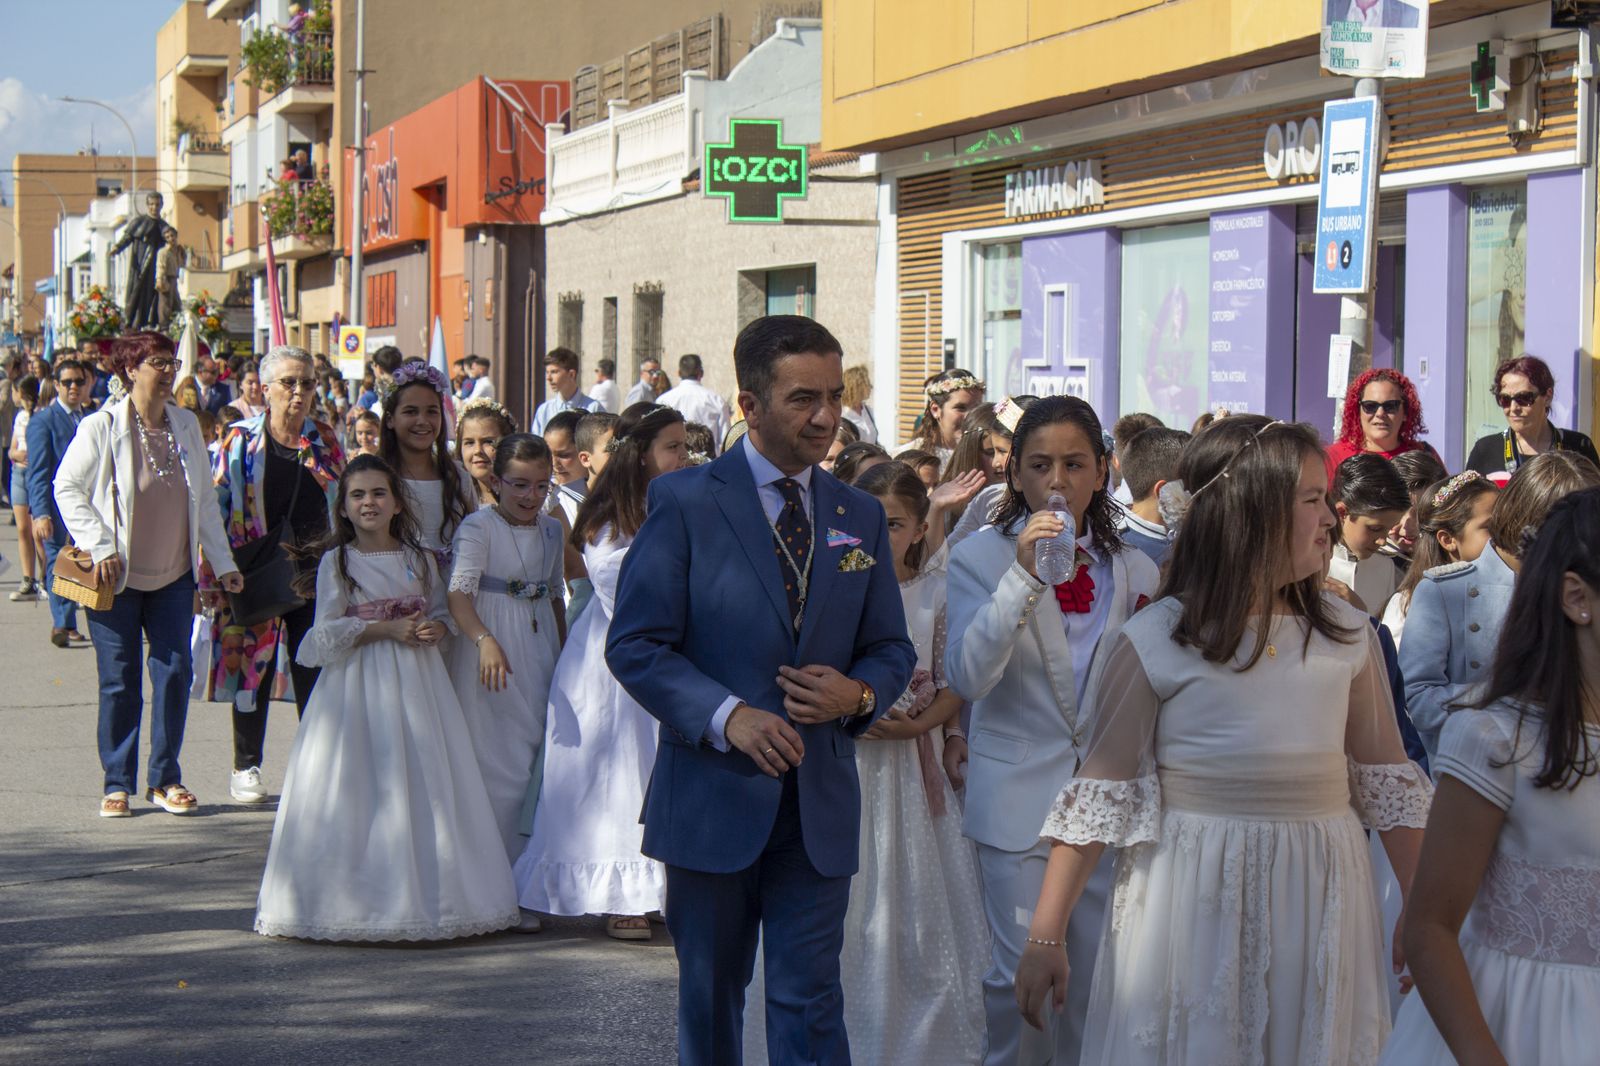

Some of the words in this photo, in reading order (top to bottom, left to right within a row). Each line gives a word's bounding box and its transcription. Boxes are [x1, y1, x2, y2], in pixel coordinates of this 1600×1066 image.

[1331, 32, 1352, 41] VAMOS
[1005, 159, 1096, 218] FARMACIA
[1321, 216, 1334, 232] BUS
[1335, 214, 1362, 231] URBANO
[1327, 247, 1336, 265] L1
[1343, 246, 1350, 263] 2
